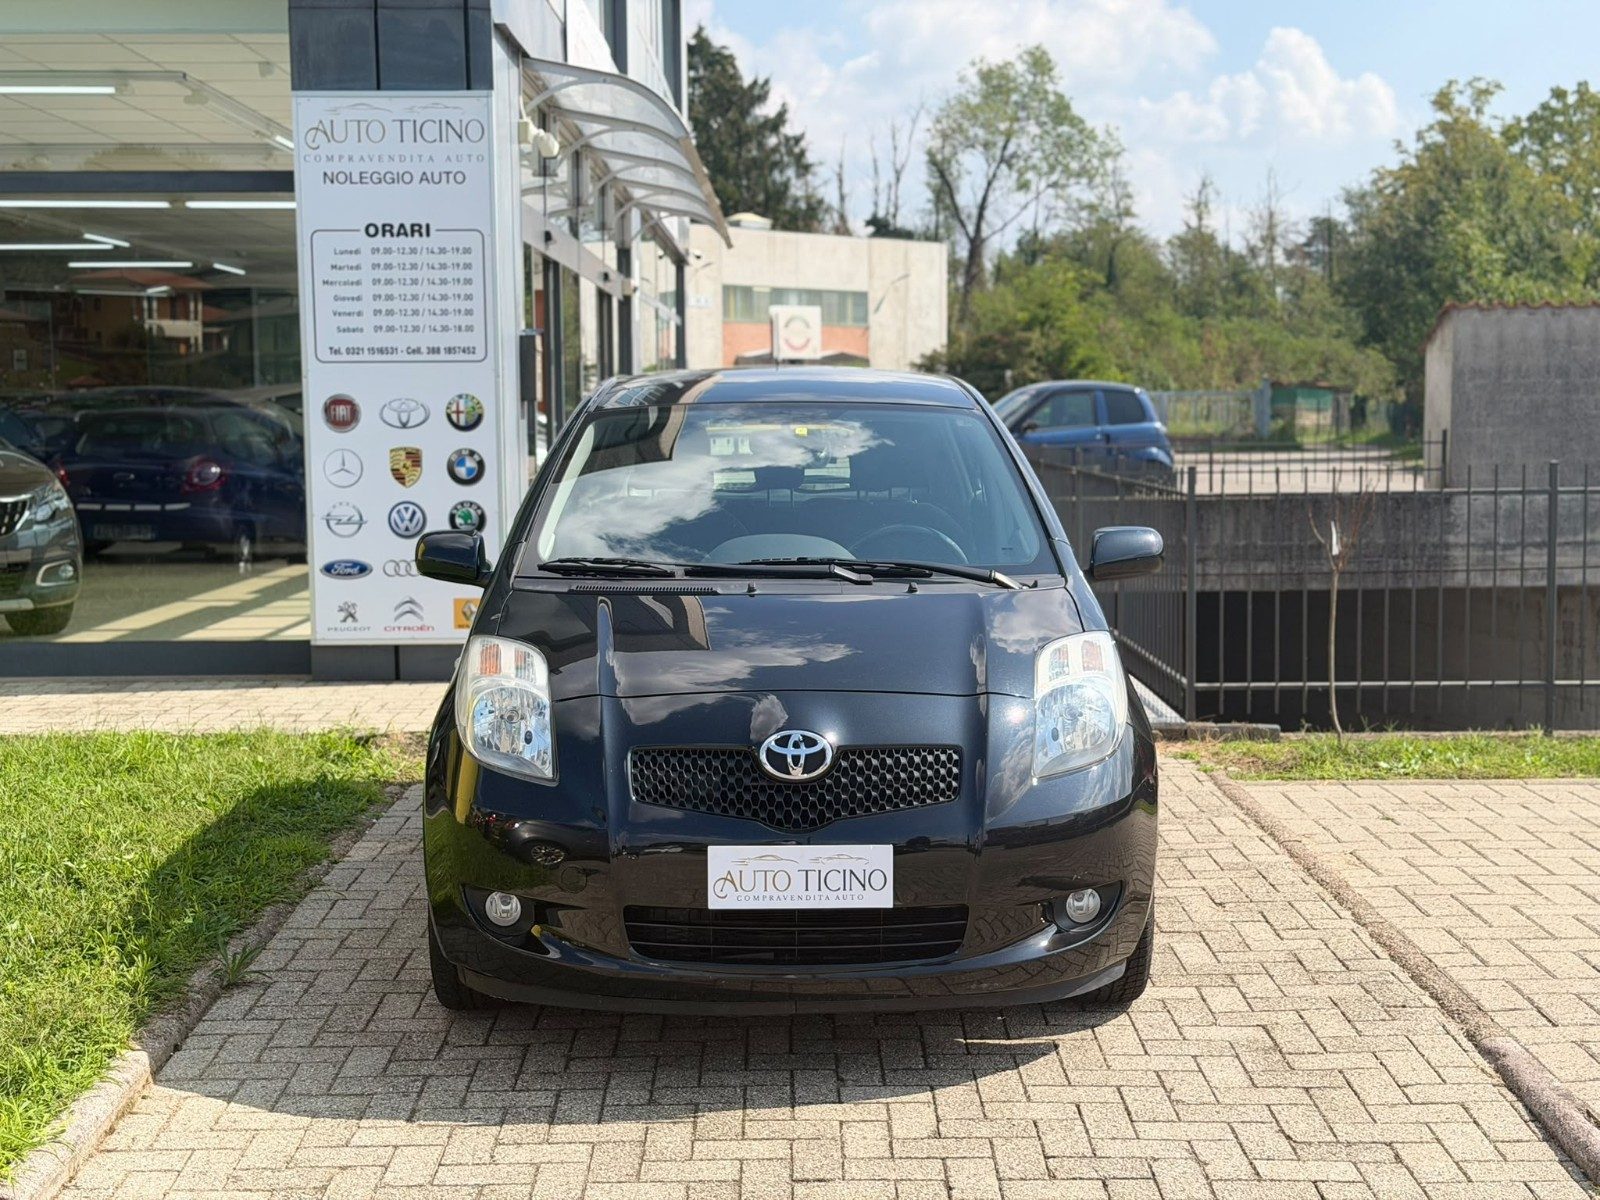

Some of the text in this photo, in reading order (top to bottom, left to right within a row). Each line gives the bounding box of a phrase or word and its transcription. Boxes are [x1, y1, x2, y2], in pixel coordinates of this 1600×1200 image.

[304, 118, 485, 150] AUTO TICINO
[303, 153, 485, 164] COMPRAVENDITA AUTO
[323, 171, 466, 185] NOLEGGIO AUTO
[364, 222, 431, 238] ORARI
[328, 346, 343, 356] Tel.
[345, 346, 365, 356] 0321
[406, 346, 422, 356] Cell.
[330, 404, 352, 421] FIAT
[330, 562, 361, 576] Ford
[713, 868, 887, 899] AUTO TICINO
[736, 894, 831, 902] COMPRAVENDITA
